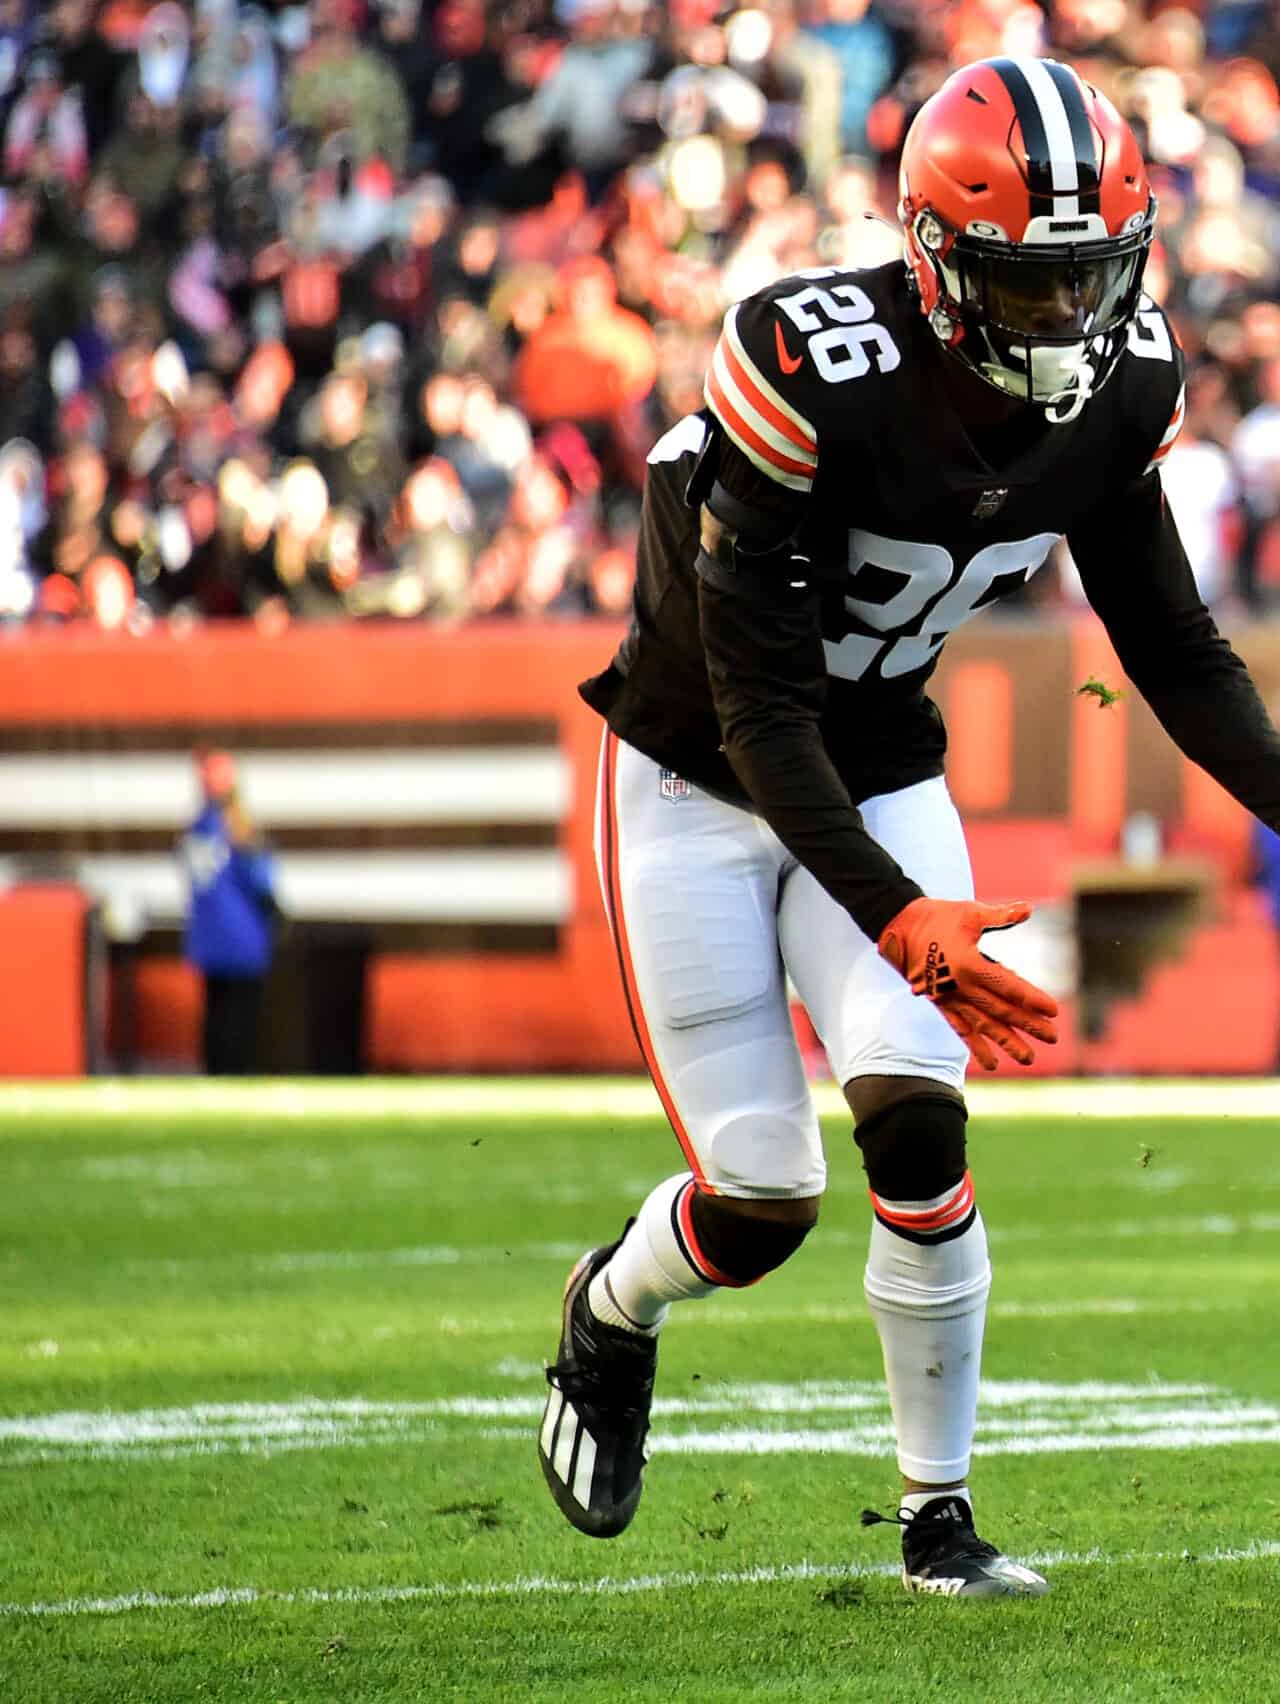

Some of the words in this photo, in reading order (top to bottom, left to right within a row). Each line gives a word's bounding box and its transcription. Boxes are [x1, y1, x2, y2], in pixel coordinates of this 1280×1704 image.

[774, 282, 901, 384] 26
[822, 527, 1067, 683] 26
[663, 780, 687, 796] NFL
